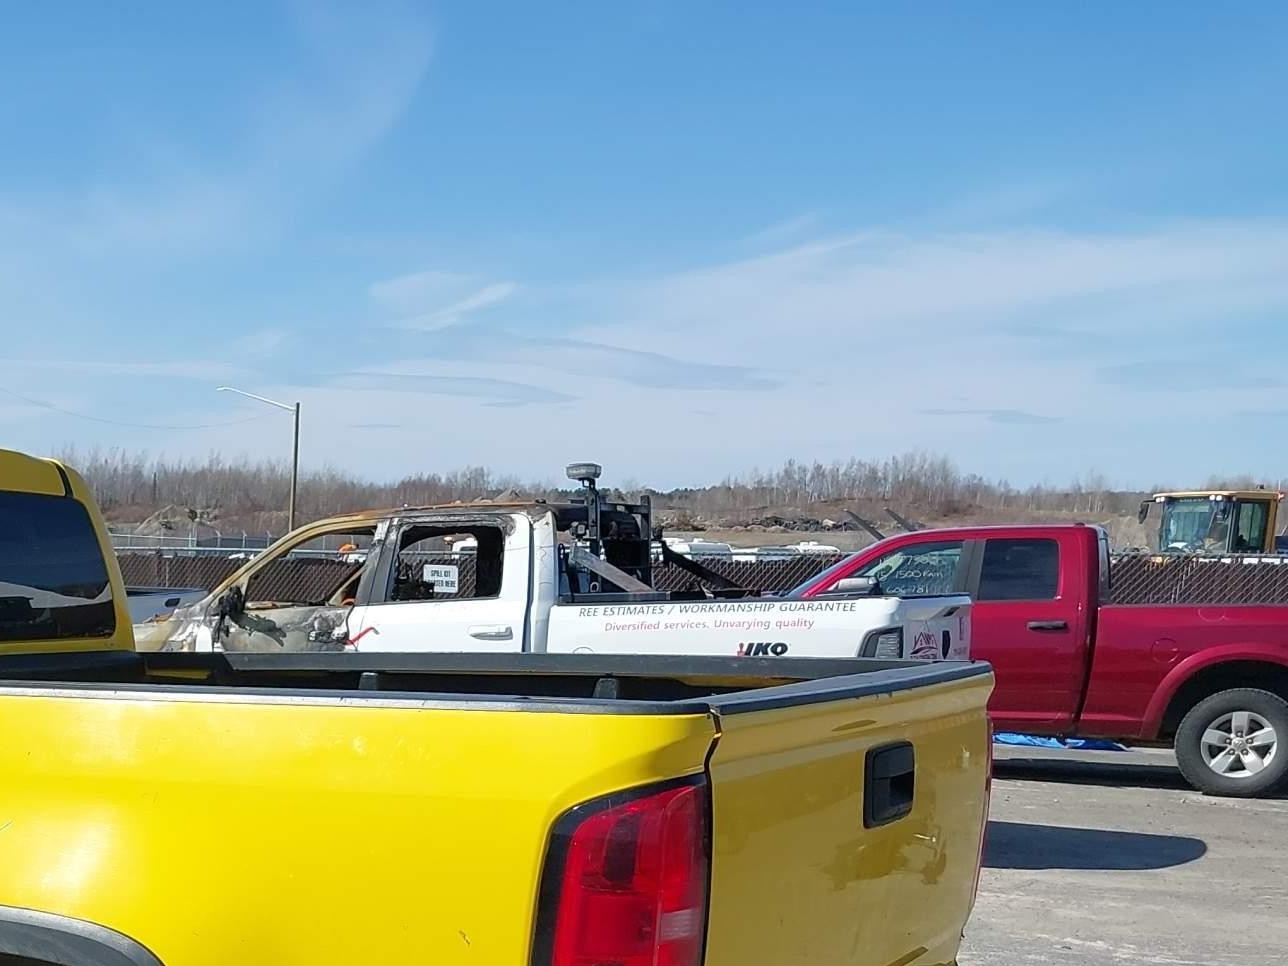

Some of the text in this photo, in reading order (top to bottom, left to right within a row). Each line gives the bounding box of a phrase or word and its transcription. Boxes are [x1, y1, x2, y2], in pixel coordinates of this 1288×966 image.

[603, 605, 665, 617] ESTIMATES
[679, 603, 775, 615] WORKMANSHIP
[779, 602, 856, 612] GUARANTEE
[604, 620, 660, 632] Diversified
[714, 618, 771, 630] Unvarying
[775, 617, 815, 629] quality
[744, 642, 789, 656] IKO
